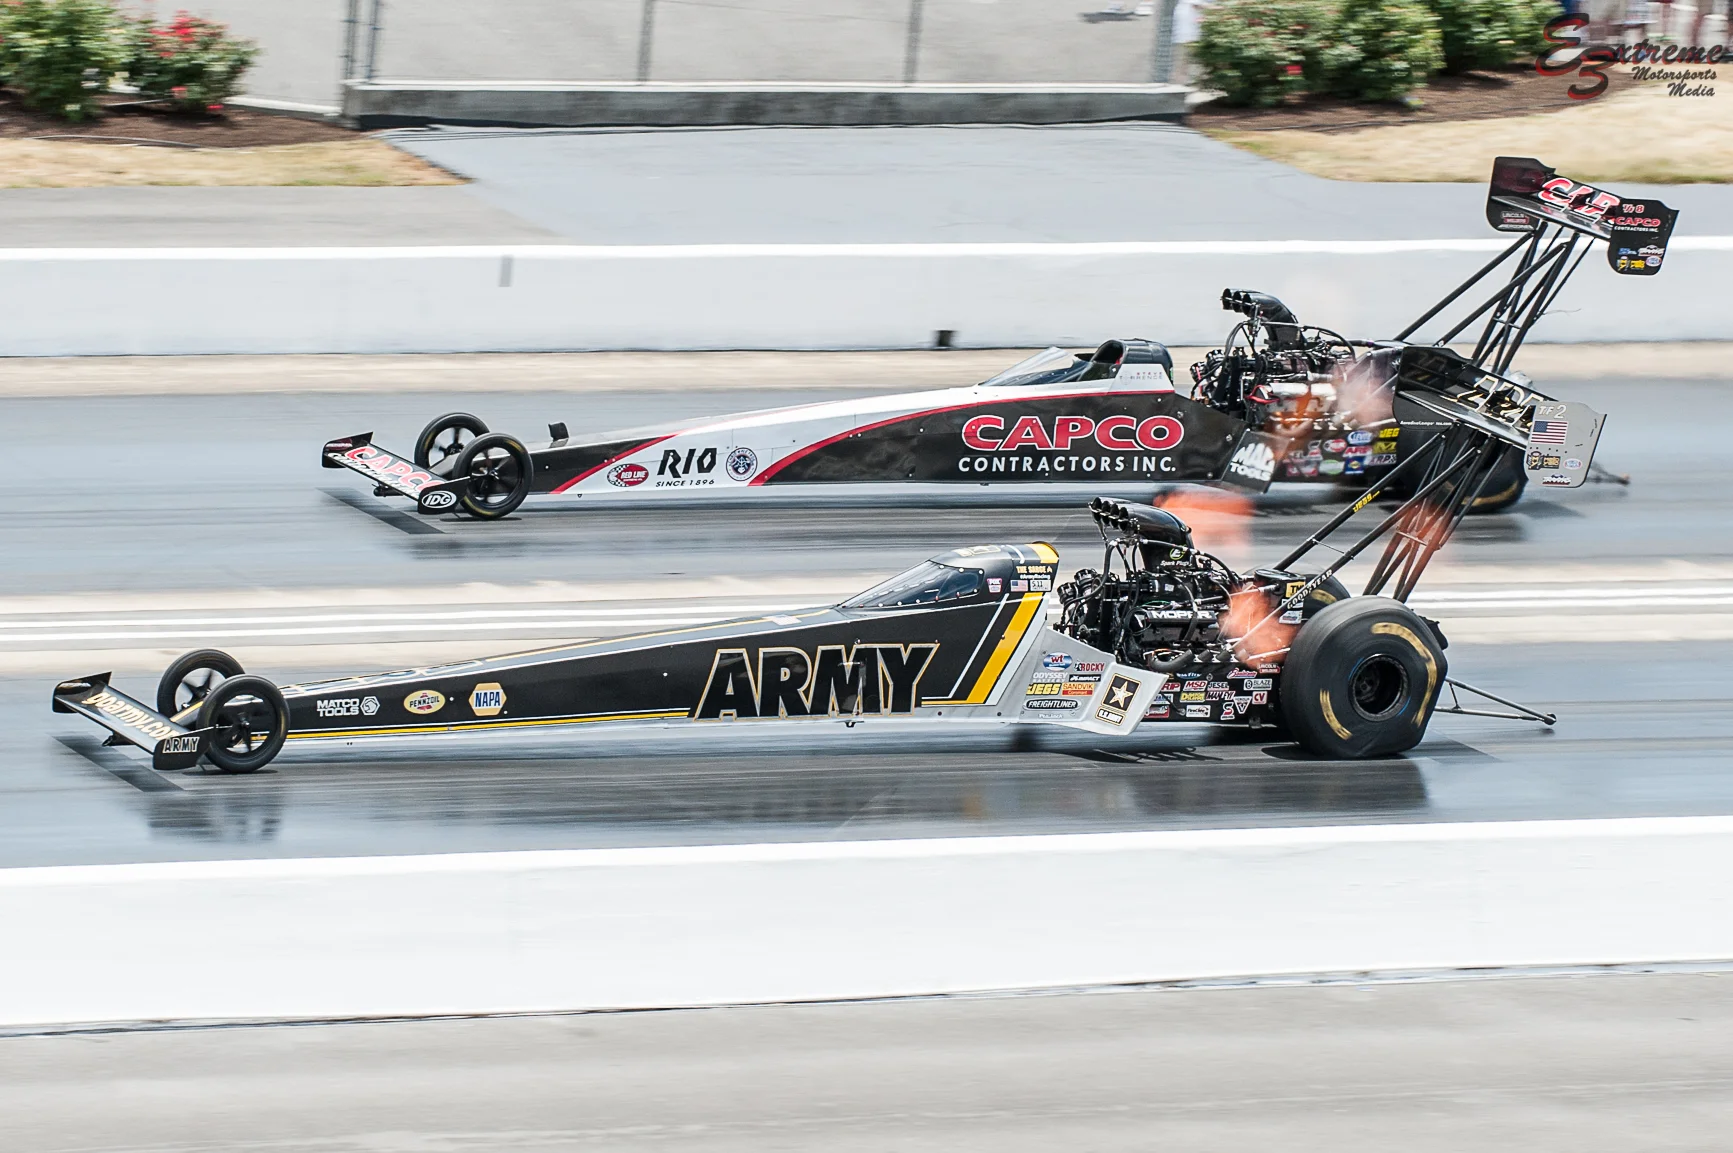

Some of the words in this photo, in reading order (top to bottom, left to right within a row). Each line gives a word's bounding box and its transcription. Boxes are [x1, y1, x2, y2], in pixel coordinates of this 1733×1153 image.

[1615, 217, 1661, 227] CAPCO
[1554, 405, 1567, 419] 2
[962, 414, 1185, 451] CAPCO
[1380, 428, 1400, 439] JEG
[657, 447, 718, 479] RIO
[958, 456, 1126, 473] CONTRACTORS
[1133, 456, 1177, 472] INC.
[1231, 443, 1276, 474] MAC
[1230, 462, 1272, 482] TOOLS
[655, 480, 686, 488] SINCE
[425, 494, 451, 506] IDG
[1287, 569, 1333, 609] GOODYEAR
[1151, 610, 1214, 619] MOPR
[1080, 662, 1105, 672] ROCKY
[693, 643, 941, 722] ARMY
[1026, 683, 1061, 695] JEGS
[409, 695, 440, 708] PENNZOIL
[475, 691, 501, 708] NAPA
[1254, 693, 1265, 701] CV
[317, 698, 360, 709] MATCO
[1028, 700, 1077, 708] FREIGHTLINER
[317, 706, 360, 717] TOOLS
[163, 736, 200, 754] ARMY
